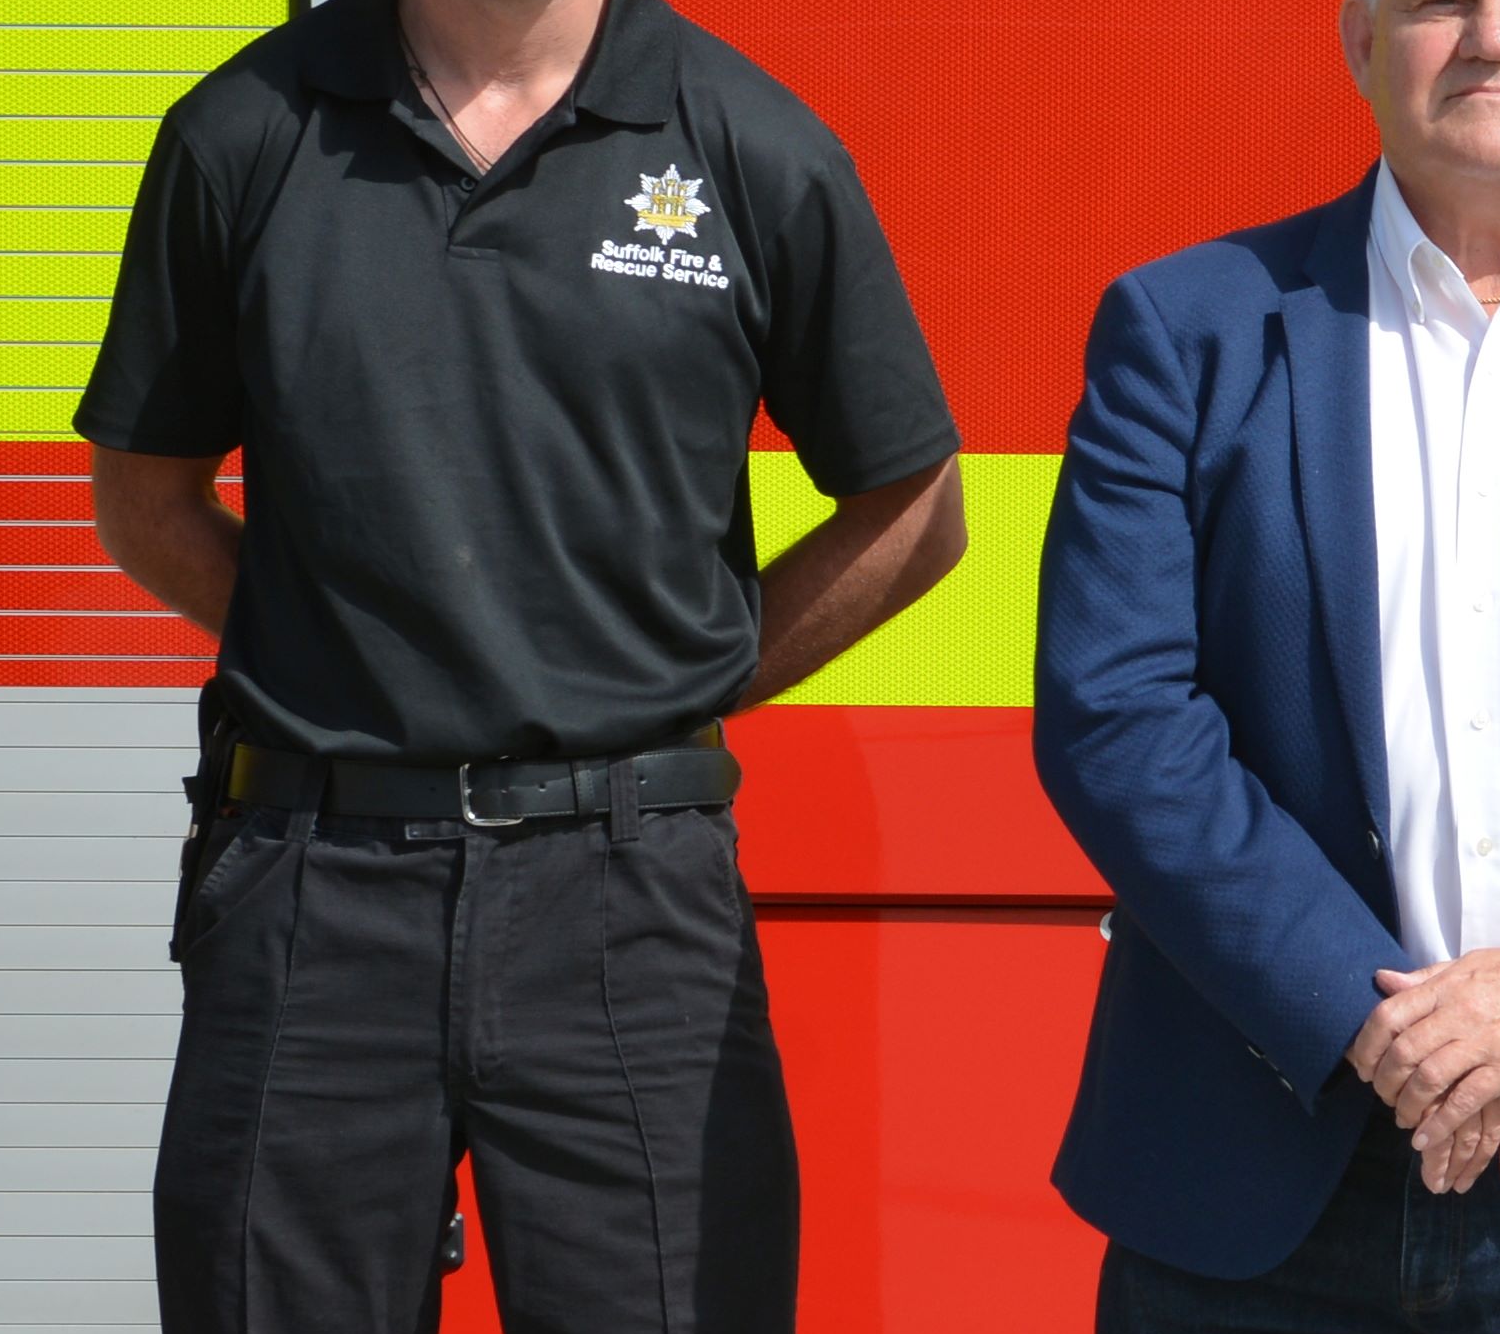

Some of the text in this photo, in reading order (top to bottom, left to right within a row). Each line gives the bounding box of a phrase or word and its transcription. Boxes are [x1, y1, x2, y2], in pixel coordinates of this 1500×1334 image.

[591, 253, 729, 290] Rescue Service
[601, 239, 722, 272] Suffolk Fire &
